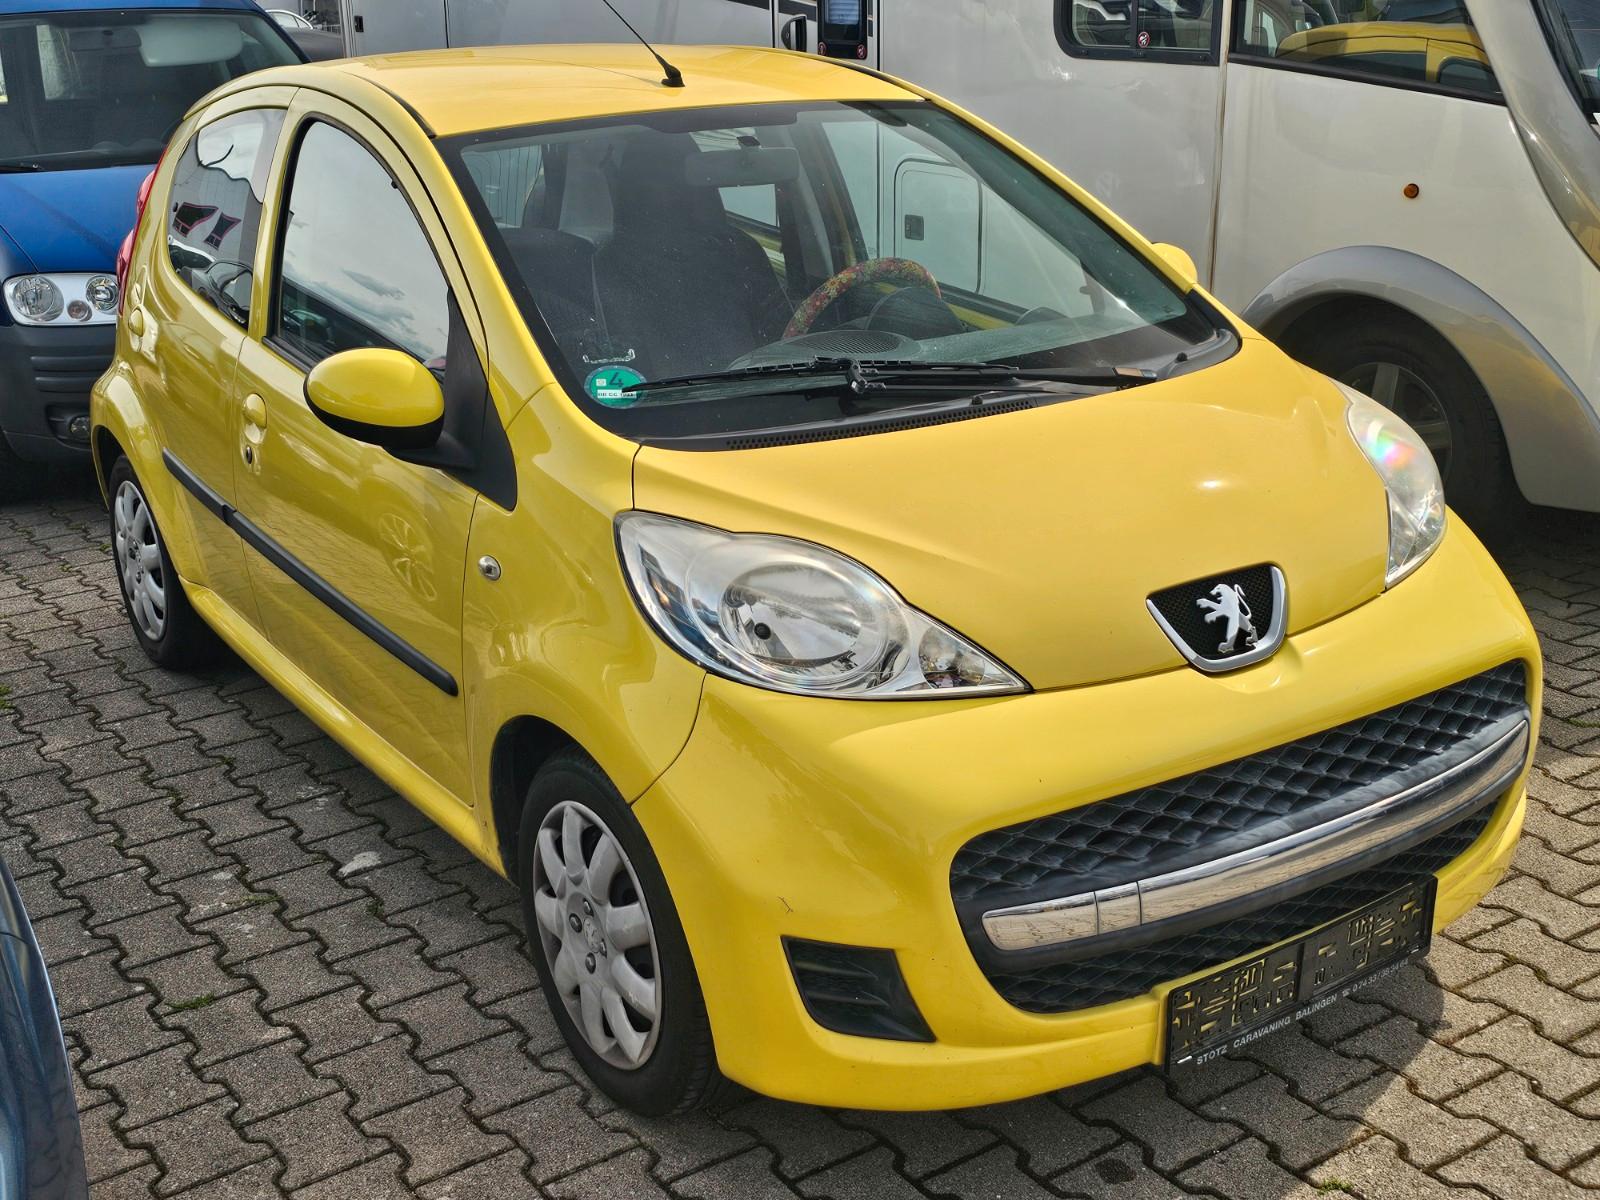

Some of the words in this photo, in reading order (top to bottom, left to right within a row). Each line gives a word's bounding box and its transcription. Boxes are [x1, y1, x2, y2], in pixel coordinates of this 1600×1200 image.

[609, 372, 624, 388] 4
[1196, 1044, 1228, 1065] STOTZ
[1233, 1016, 1291, 1048] CARAVANING
[1295, 993, 1338, 1020] BALINGEN
